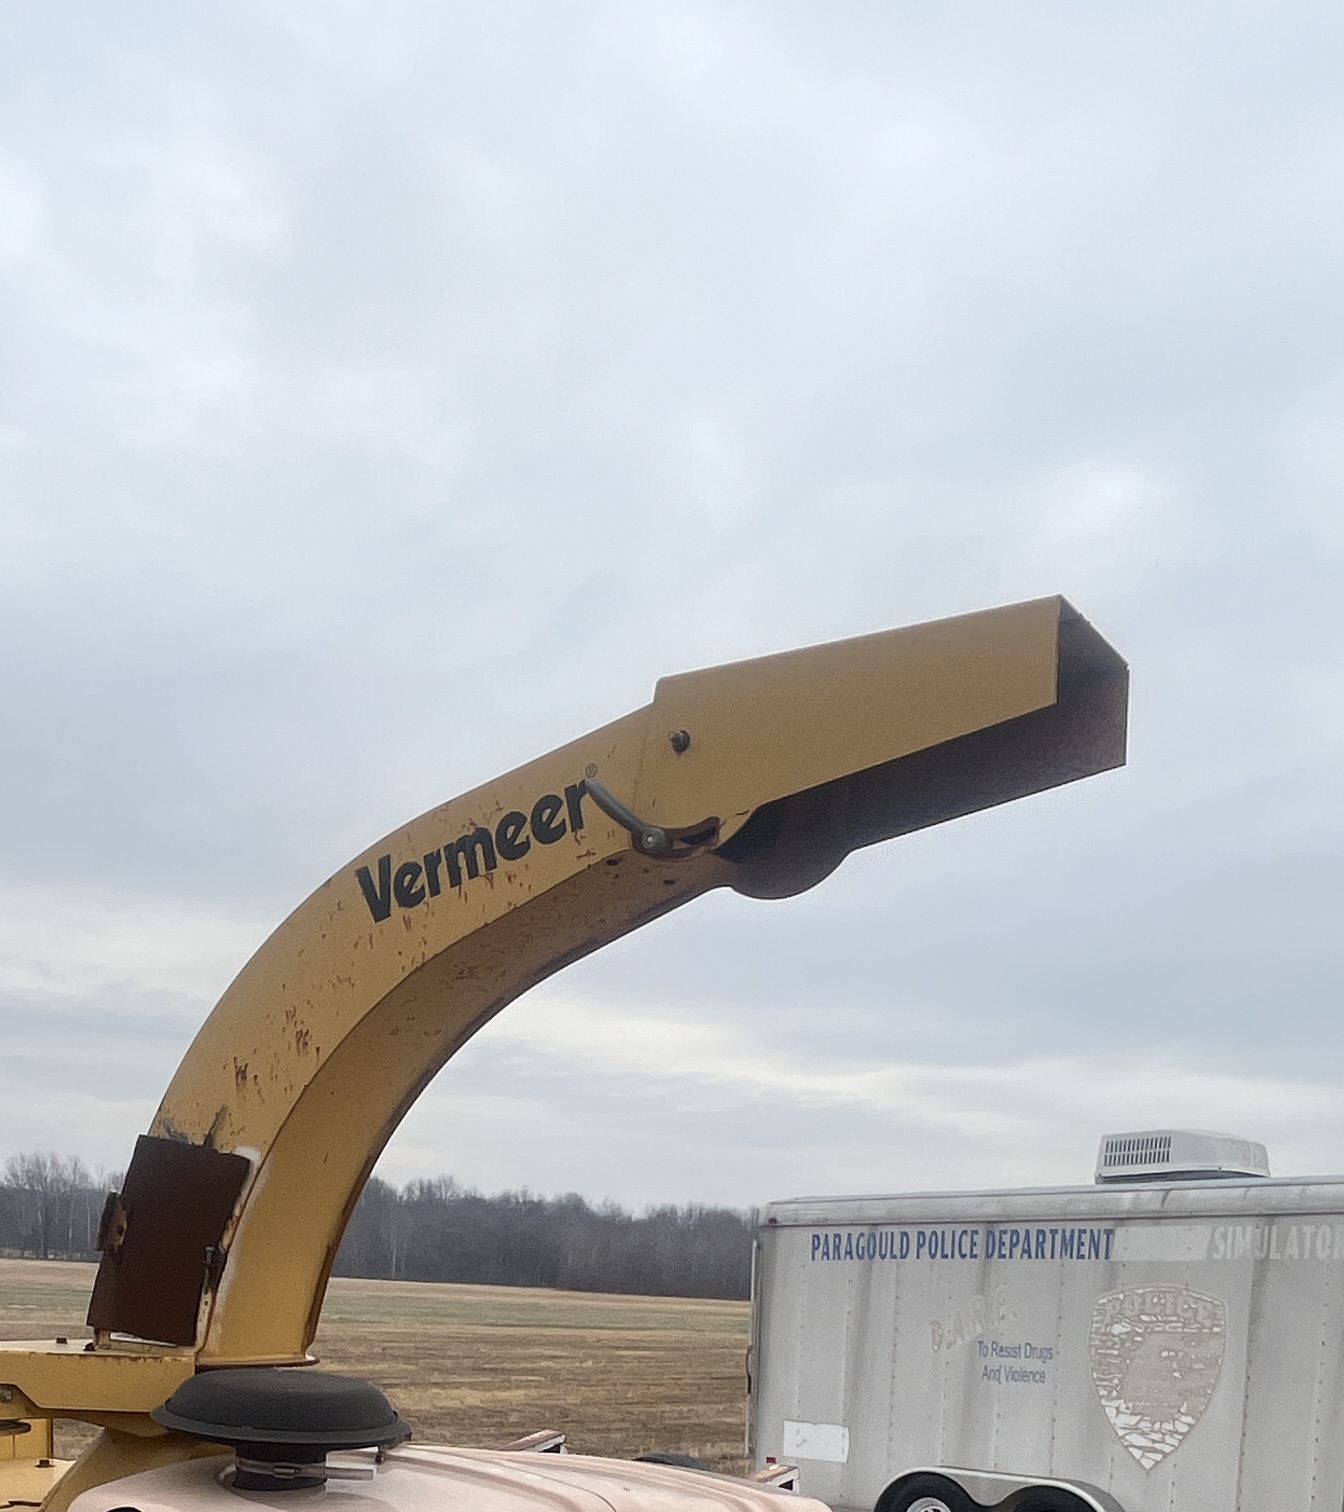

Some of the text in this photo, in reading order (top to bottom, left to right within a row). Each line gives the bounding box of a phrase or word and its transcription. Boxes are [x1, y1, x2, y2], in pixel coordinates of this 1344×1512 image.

[356, 779, 587, 924] Vermeer
[811, 1228, 1115, 1261] PARAGOULD POLICE DEPARTMENT
[977, 1340, 1053, 1364] To Resist Drugs
[981, 1365, 1046, 1384] And Violence
